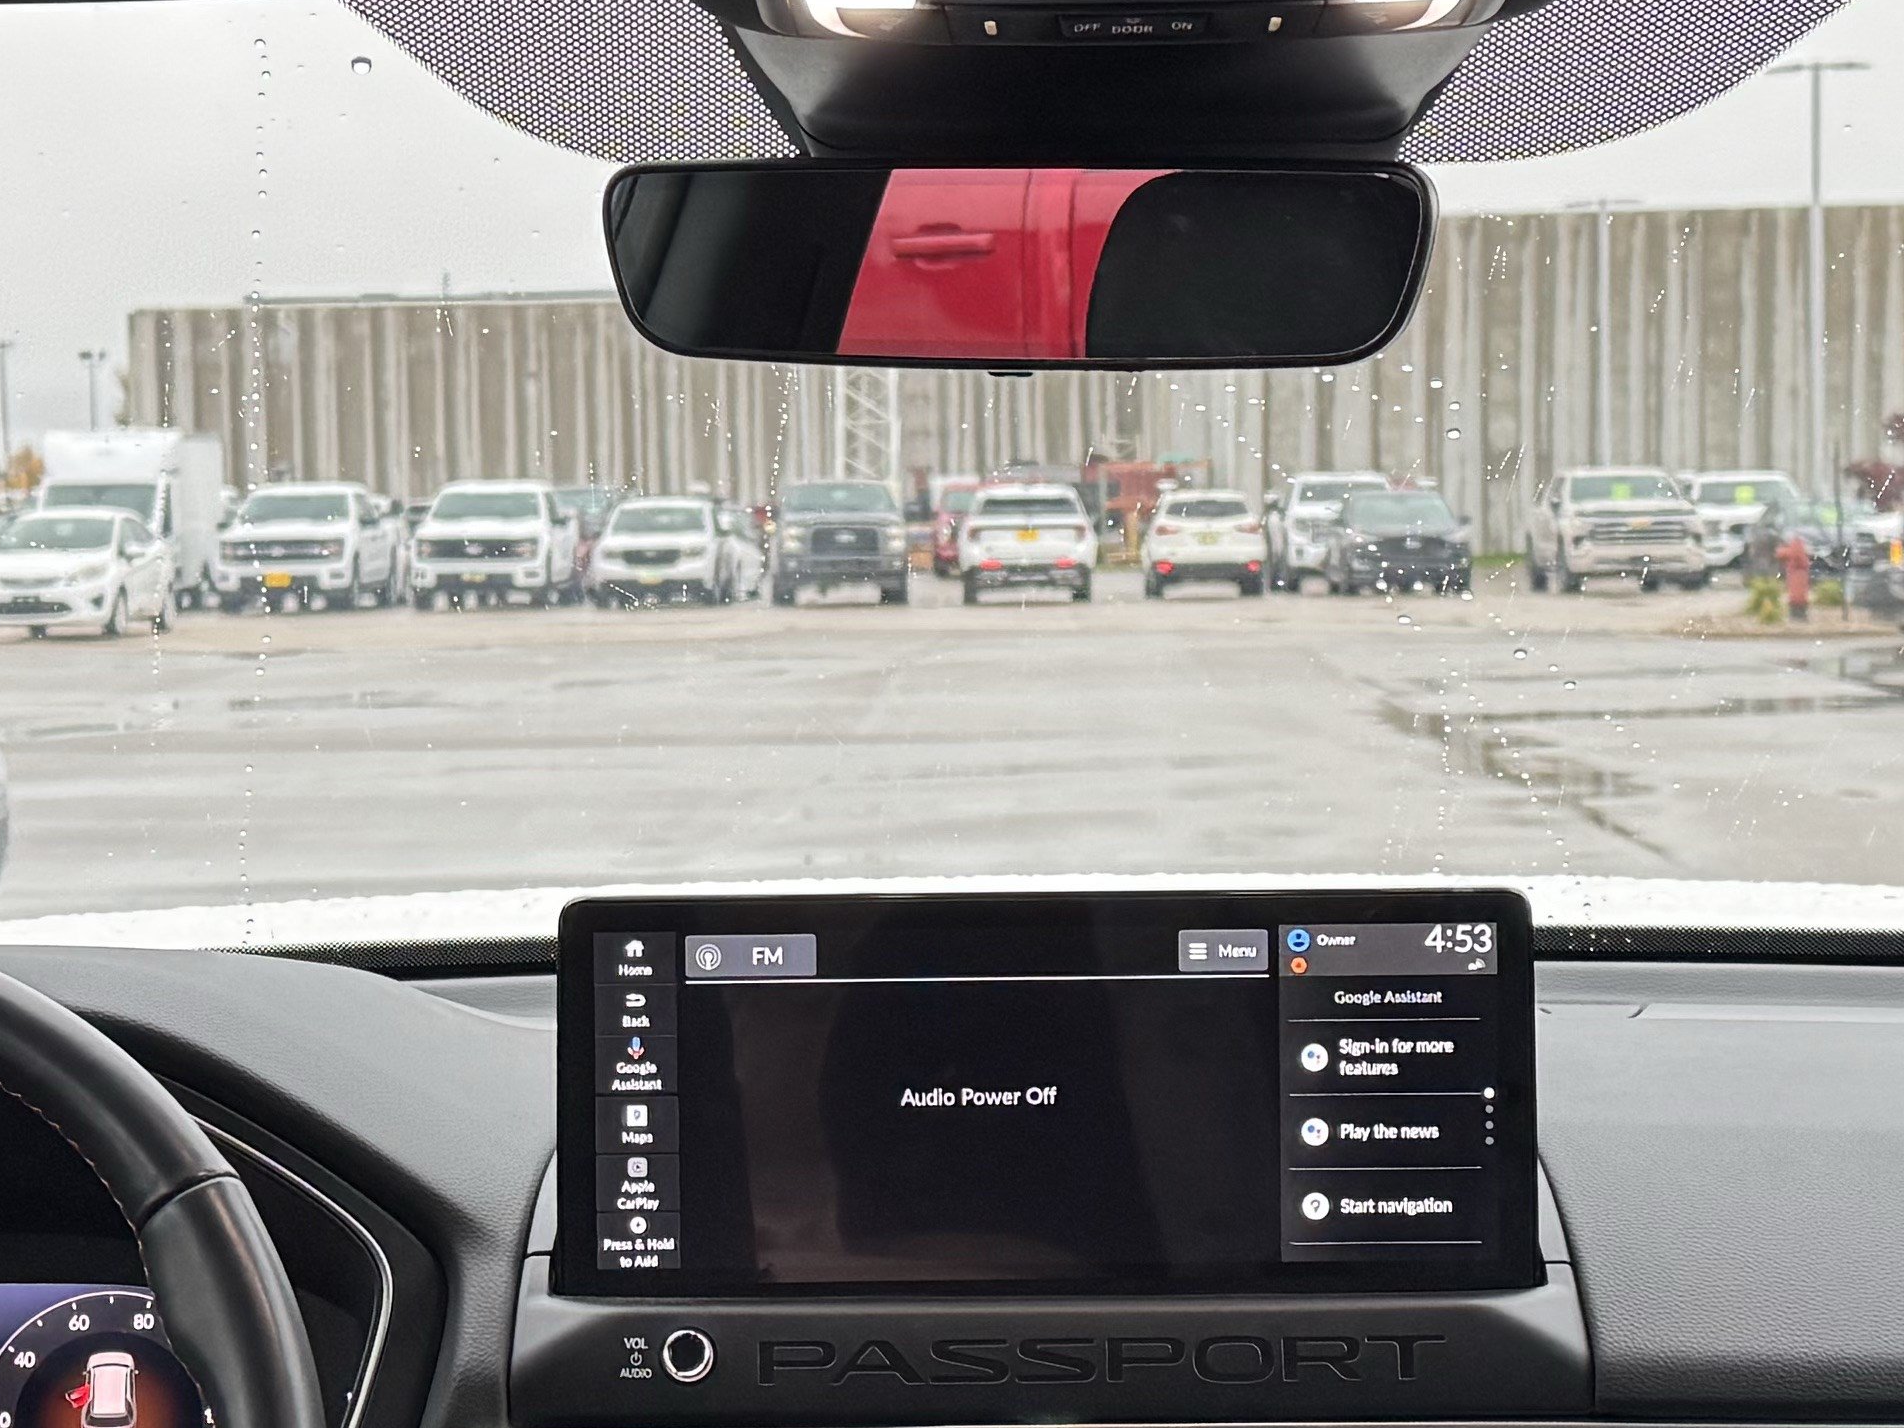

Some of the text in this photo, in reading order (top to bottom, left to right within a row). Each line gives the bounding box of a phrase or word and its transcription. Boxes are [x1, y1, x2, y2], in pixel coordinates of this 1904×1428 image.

[1074, 23, 1101, 34] OFF
[1171, 21, 1192, 32] ON
[1316, 933, 1356, 946] Owner
[1424, 923, 1493, 954] 4:53
[752, 947, 784, 965] FM
[1218, 944, 1256, 958] Menu
[618, 963, 653, 977] Home
[1334, 990, 1443, 1006] Google Assistant
[622, 1015, 651, 1028] Back
[1392, 1039, 1414, 1053] for
[1416, 1041, 1454, 1054] more
[615, 1061, 658, 1077] Google
[1339, 1060, 1398, 1076] features
[611, 1077, 663, 1091] Assistant
[900, 1087, 1058, 1107] Audio Power Off
[622, 1131, 653, 1147] Maps
[1340, 1124, 1440, 1141] Play the news
[621, 1180, 655, 1196] Apple
[617, 1197, 660, 1212] CarPlay
[1340, 1198, 1453, 1215] Start navigation
[603, 1238, 675, 1252] Press & Hold
[619, 1255, 660, 1269] to Add
[68, 1314, 90, 1332] 60
[133, 1313, 155, 1330] 80
[623, 1337, 649, 1349] VOL
[14, 1351, 36, 1368] 40
[755, 1334, 1450, 1387] PASSPORT
[619, 1367, 653, 1379] AUDIO
